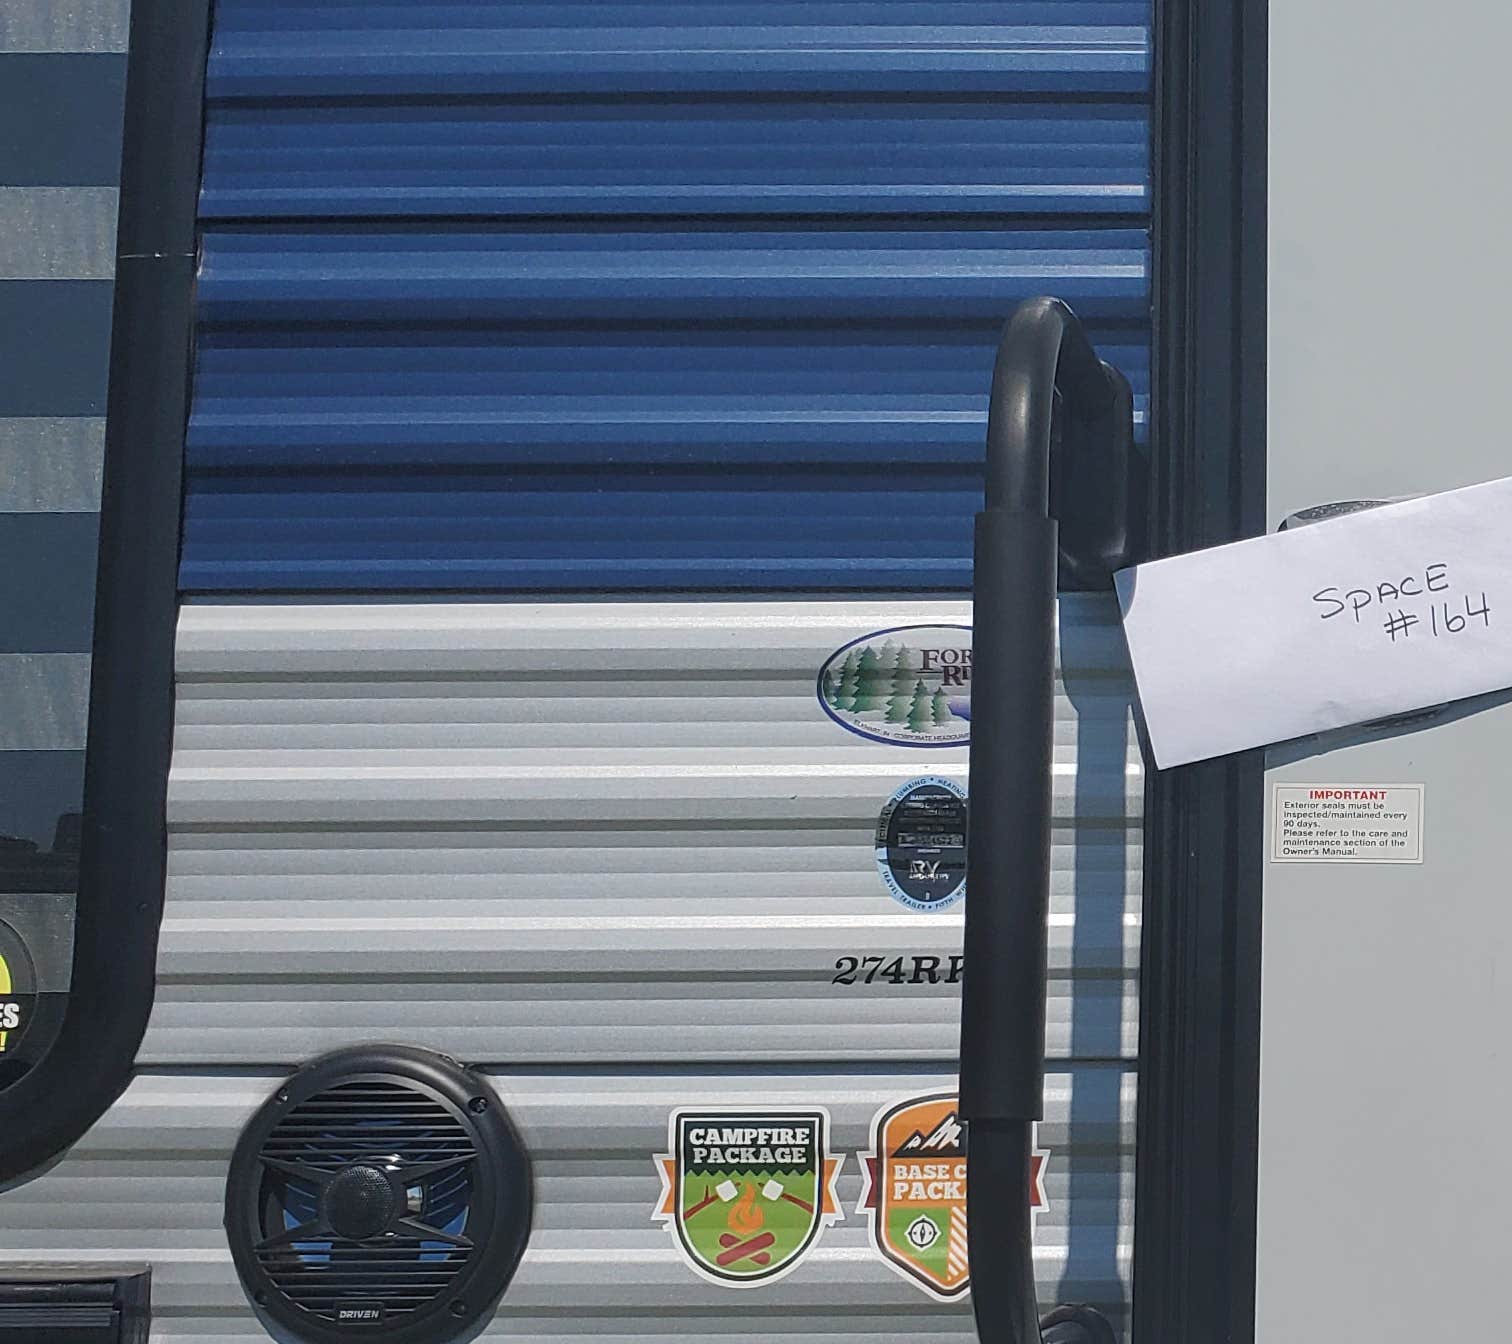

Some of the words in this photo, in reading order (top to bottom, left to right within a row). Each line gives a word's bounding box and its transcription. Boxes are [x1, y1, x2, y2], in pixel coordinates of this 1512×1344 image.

[1312, 562, 1450, 622] SPACE
[1384, 593, 1490, 641] #164
[919, 648, 973, 671] FOR
[1309, 790, 1387, 800] IMPORTANT
[1283, 801, 1319, 809] Exterior
[1348, 802, 1371, 810] must
[1373, 802, 1385, 810] be
[1383, 812, 1408, 821] every
[1283, 829, 1314, 837] Please
[1316, 829, 1337, 837] refer
[1340, 829, 1350, 837] to
[1352, 829, 1366, 837] the
[1391, 829, 1408, 838] and
[1343, 839, 1377, 847] section
[1379, 839, 1389, 847] of
[1391, 839, 1406, 847] the
[1283, 847, 1319, 855] Owner's
[689, 1127, 811, 1146] CAMPFIRE
[692, 1147, 807, 1164] PACKAGE
[893, 1164, 951, 1181] BASE
[893, 1181, 967, 1201] PACK
[339, 1309, 381, 1319] DRIVEN
